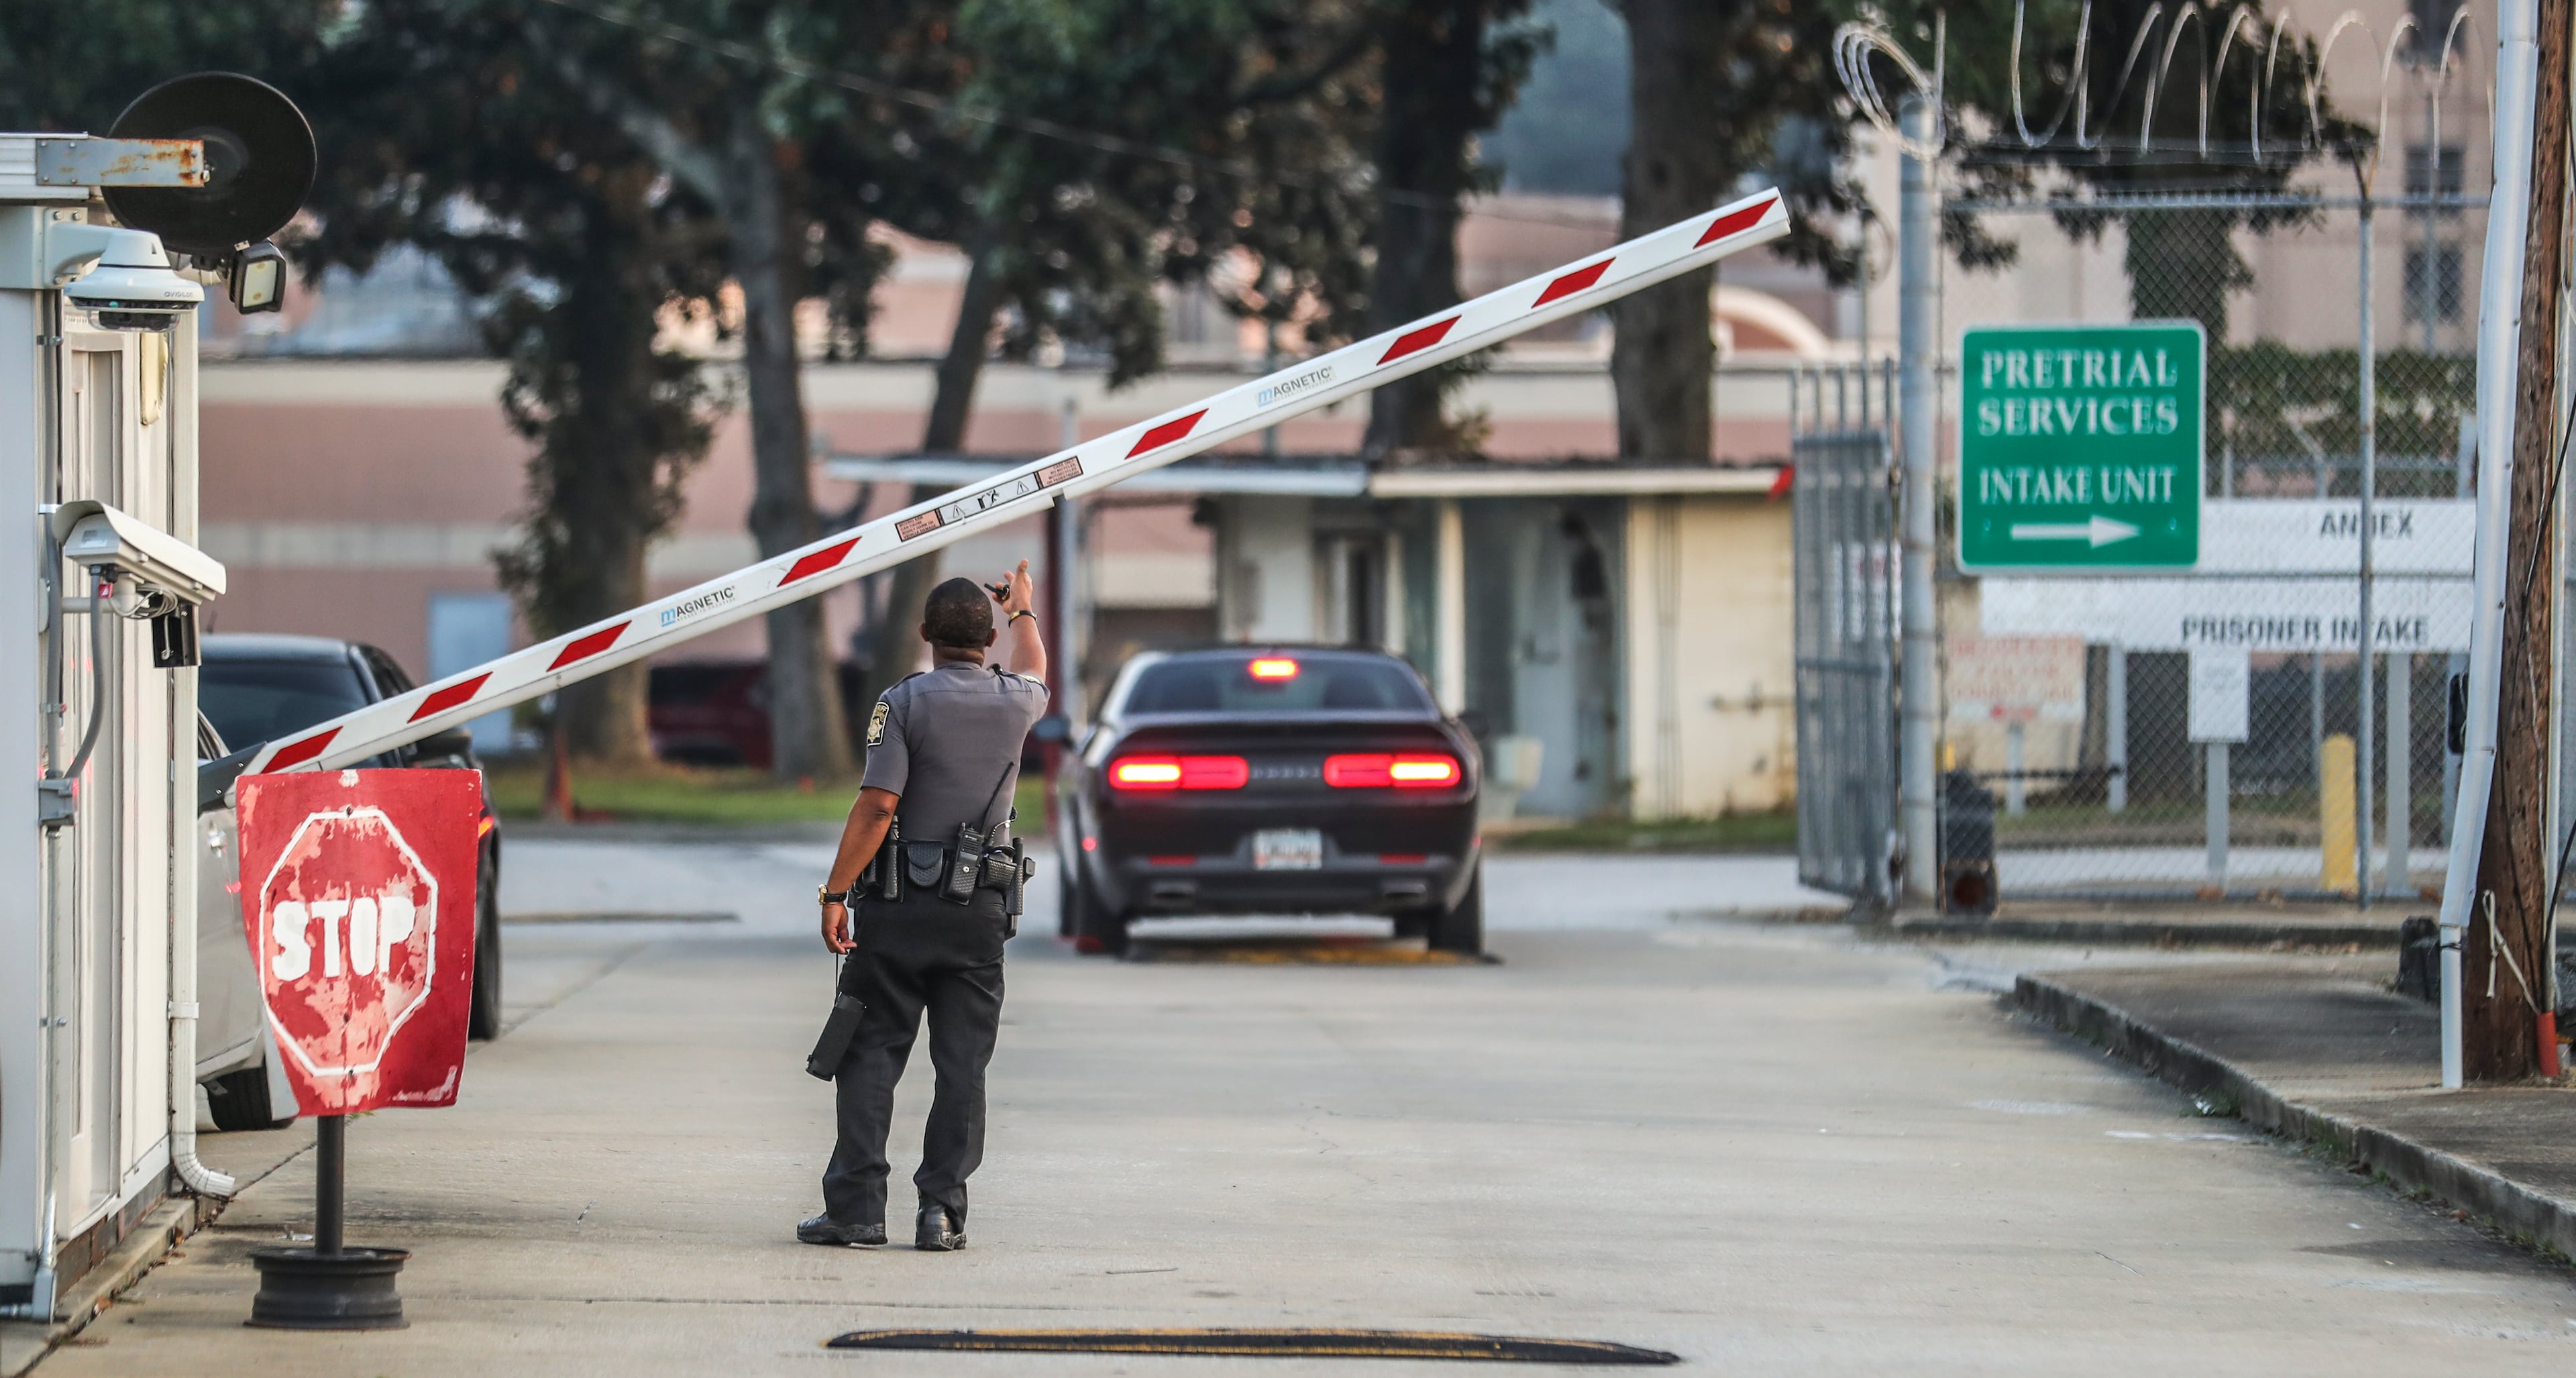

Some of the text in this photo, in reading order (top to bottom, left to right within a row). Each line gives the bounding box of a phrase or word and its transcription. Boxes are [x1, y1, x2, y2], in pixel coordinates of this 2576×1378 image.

[1981, 348, 2178, 389] PRETRIAL
[1978, 394, 2180, 437] SERVICES
[1980, 464, 2178, 505] INTAKE UNIT
[2181, 614, 2428, 646] PRISONER INAKE
[270, 896, 417, 982] STOP
